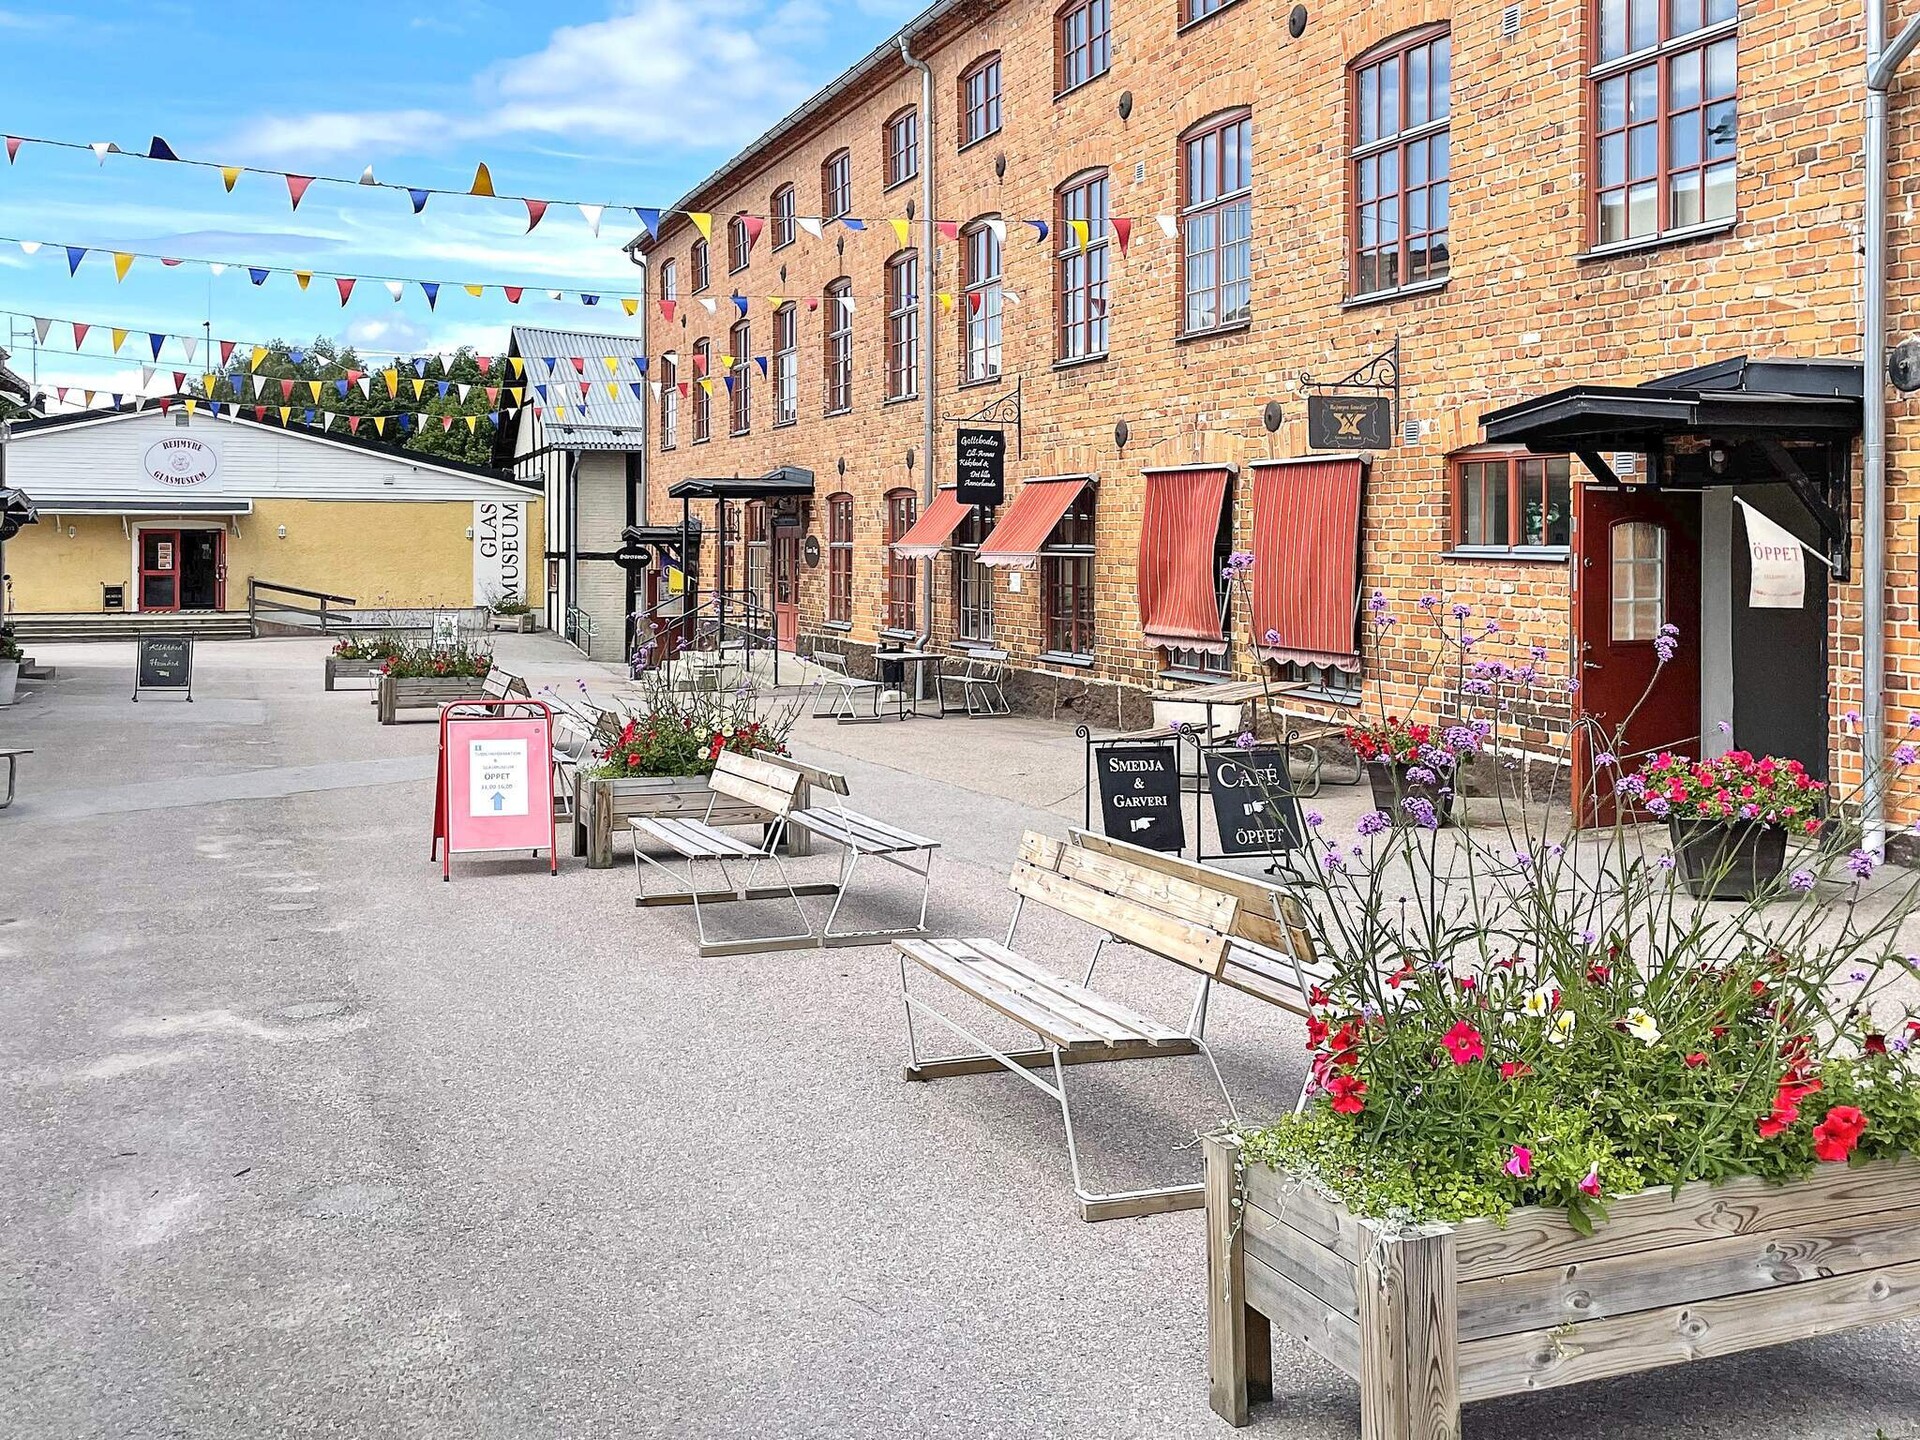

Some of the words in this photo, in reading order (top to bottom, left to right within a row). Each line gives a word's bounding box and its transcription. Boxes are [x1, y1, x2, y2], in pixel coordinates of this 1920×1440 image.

[153, 470, 207, 485] GLASMUSEUM
[480, 503, 498, 558] GLAS
[502, 503, 519, 601] MUSEUM
[1753, 542, 1800, 561] ÖPPET
[1109, 757, 1164, 772] SMEDJA
[484, 771, 511, 781] ÖPPET
[1216, 763, 1280, 788] CAFÉ
[1133, 778, 1145, 790] &
[1113, 794, 1168, 808] GARVERI
[1235, 828, 1285, 845] ÖPPET
